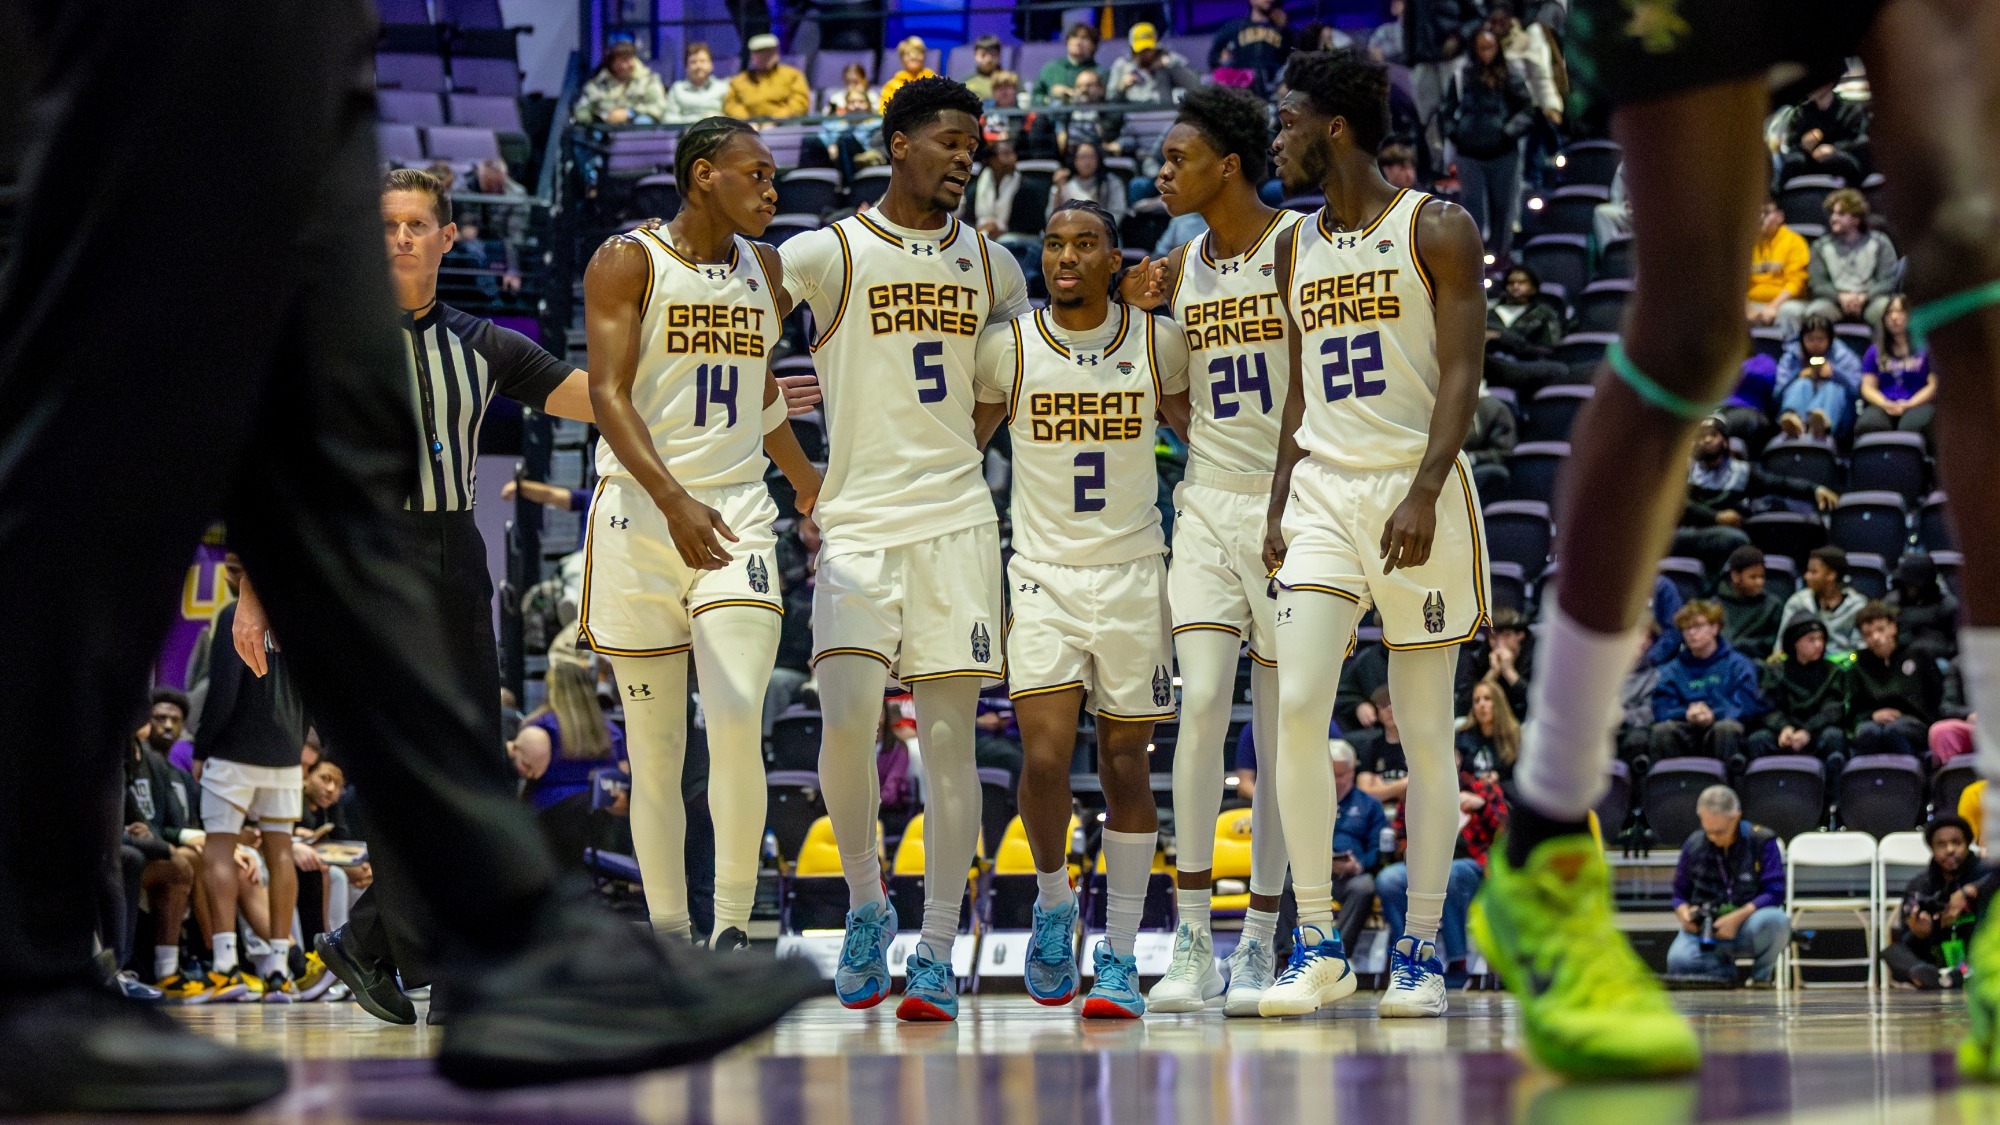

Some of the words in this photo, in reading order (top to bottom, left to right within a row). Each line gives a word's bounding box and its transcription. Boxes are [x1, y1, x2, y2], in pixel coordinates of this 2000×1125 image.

[868, 282, 979, 311] GREAT
[1299, 268, 1400, 307] GREAT
[667, 303, 766, 331] GREAT
[870, 307, 979, 337] DANES
[1184, 292, 1279, 327] GREAT
[1300, 294, 1401, 334] DANES
[666, 329, 766, 358] DANES
[1185, 317, 1284, 352] DANES
[912, 341, 947, 404] 5
[1320, 330, 1387, 404] 22
[693, 363, 739, 429] 14
[1030, 390, 1145, 417] GREAT
[1208, 352, 1273, 420] 24
[1031, 416, 1143, 443] DANES
[1073, 451, 1106, 513] 2
